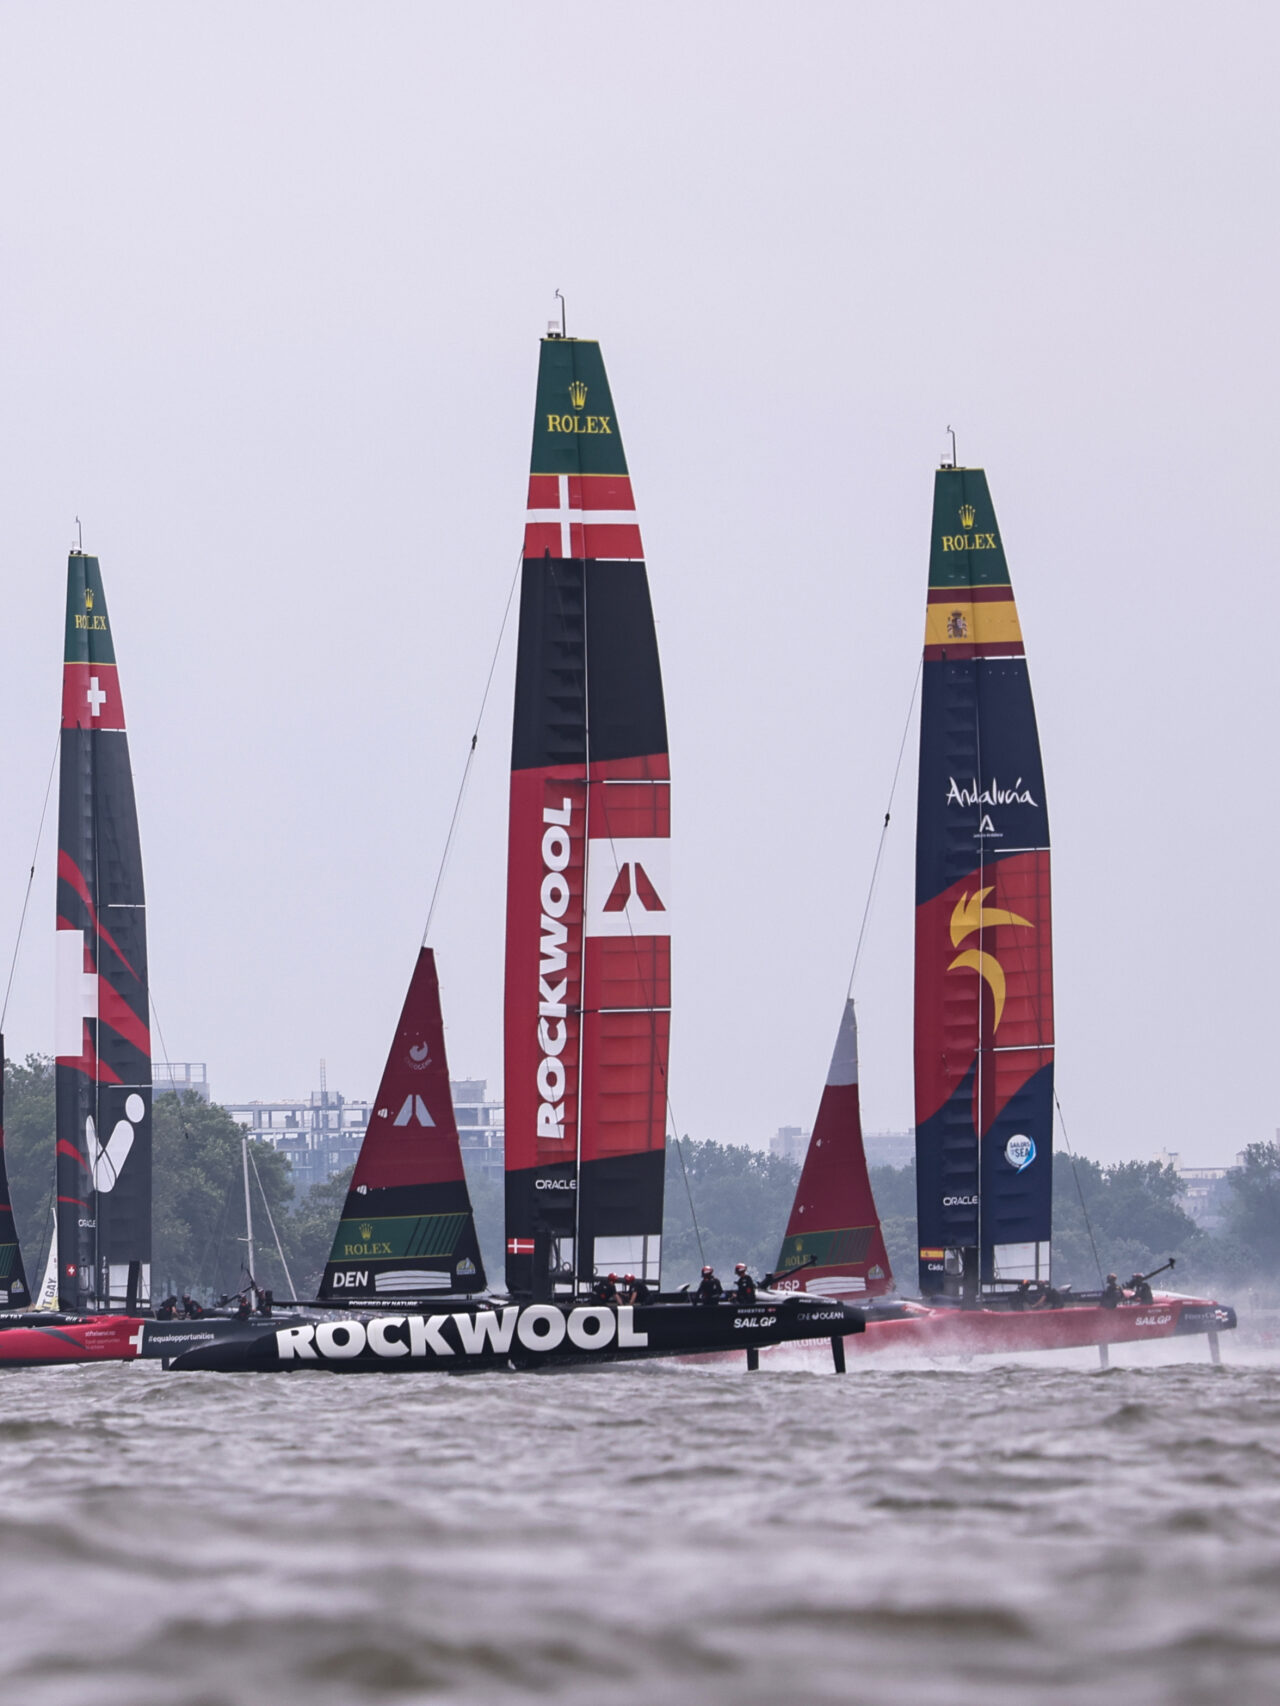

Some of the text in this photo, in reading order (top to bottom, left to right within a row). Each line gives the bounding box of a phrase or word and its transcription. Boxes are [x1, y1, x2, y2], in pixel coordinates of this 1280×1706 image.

[546, 414, 612, 434] ROLEX
[941, 533, 997, 552] ROLEX
[74, 614, 107, 630] ROLEX
[945, 776, 1039, 808] Andalucía
[536, 797, 572, 1139] ROCKWOOL
[535, 1179, 577, 1190] ORACLE
[942, 1195, 979, 1206] ORACLE
[344, 1242, 393, 1256] ROLEX
[332, 1270, 369, 1288] DEN
[777, 1280, 800, 1291] ESP
[148, 1332, 215, 1345] #equalopportunities
[275, 1303, 649, 1360] ROCKWOOL
